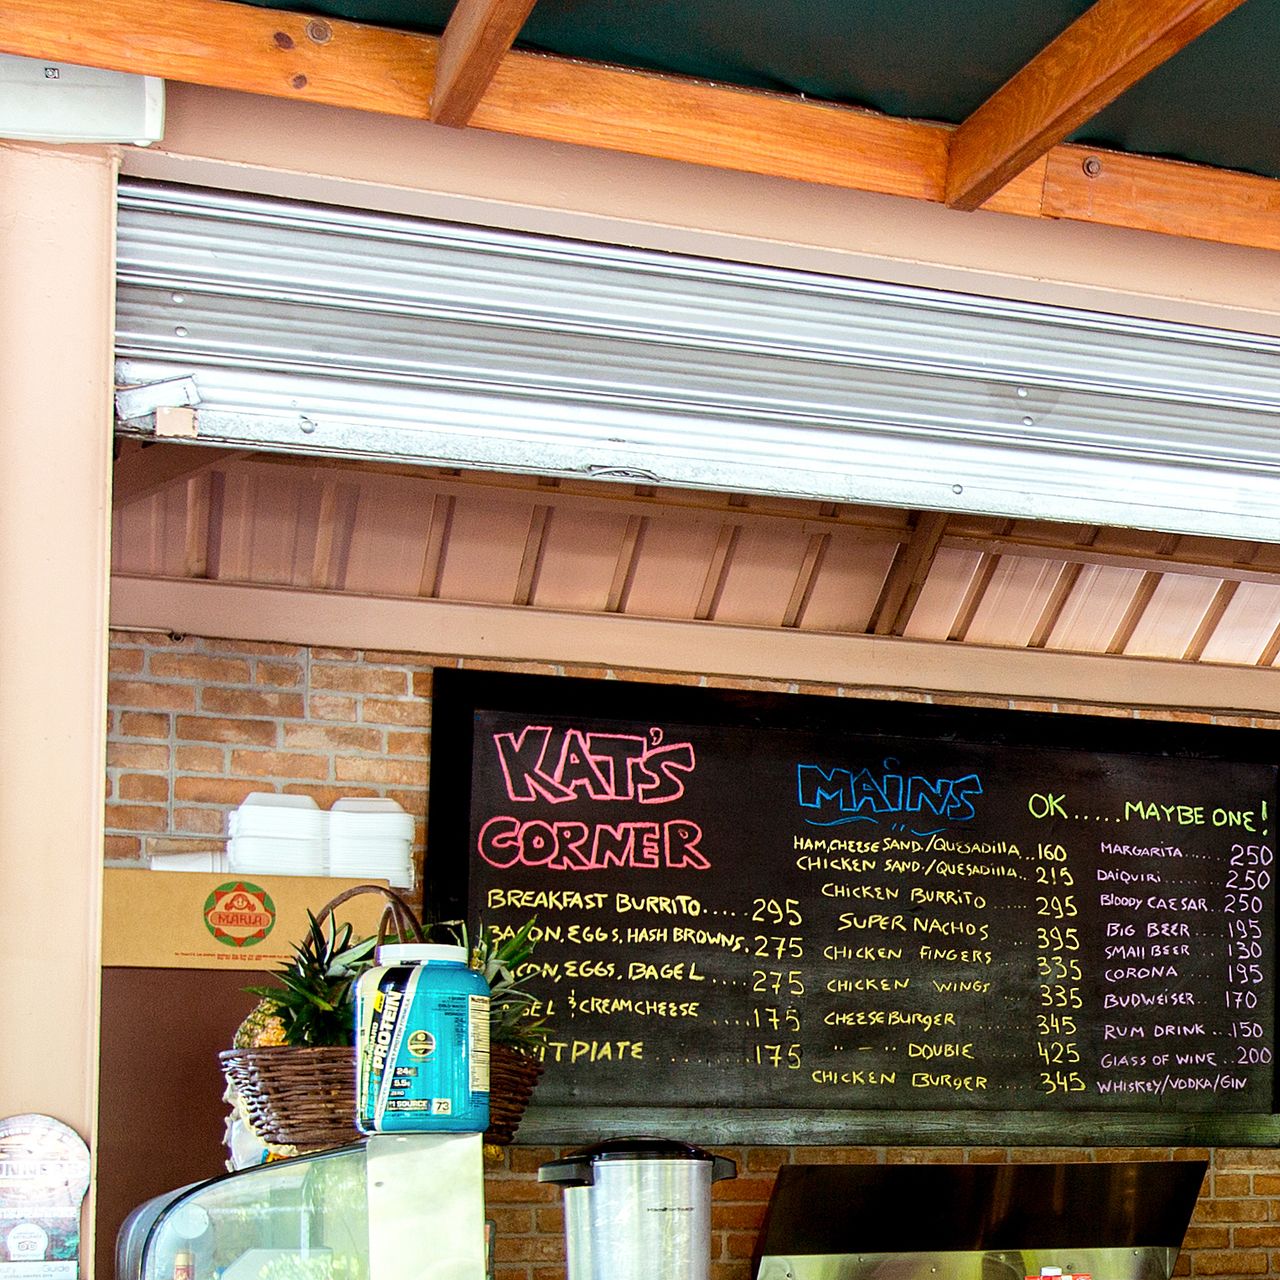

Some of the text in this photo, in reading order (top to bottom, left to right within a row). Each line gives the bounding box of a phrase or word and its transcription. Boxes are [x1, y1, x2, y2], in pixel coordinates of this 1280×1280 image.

[494, 726, 695, 804] KAT'S
[1125, 801, 1204, 825] MAYBE
[478, 816, 711, 870] CORNER
[1038, 843, 1067, 862] 160
[1230, 844, 1273, 866] 250
[796, 856, 876, 872] CHICKEN
[1035, 866, 1074, 886] 215
[1225, 870, 1270, 890] 250
[487, 888, 803, 926] BREAKFAST BURRITO 295
[1036, 896, 1078, 919] 295
[1147, 897, 1208, 912] CAESAR
[1224, 894, 1263, 914] 250
[218, 914, 262, 924] MARIA
[1106, 919, 1262, 939] BIG BEER 195
[627, 928, 668, 943] HASH
[754, 935, 803, 959] 275
[837, 913, 1080, 951] SUPER NACHOS 395
[1151, 945, 1190, 957] BEER
[1228, 941, 1263, 959] 130
[823, 946, 1082, 981] CHICKEN FINGERS 335
[1104, 963, 1264, 984] CORONA 195
[628, 962, 705, 982] BAGEL
[752, 970, 805, 996] 275
[826, 978, 1083, 1009] CHICKEN WINGS 335
[1225, 990, 1258, 1009] 170
[373, 991, 403, 1070] PROTEIN
[754, 1008, 801, 1032] 175
[1037, 1013, 1077, 1035] 345
[1104, 1021, 1264, 1040] RUM DRINK 150
[756, 1043, 801, 1070] 175
[1038, 1042, 1080, 1065] 425
[1152, 1054, 1169, 1066] OF
[1176, 1052, 1217, 1067] WINE
[1237, 1046, 1272, 1065] 200
[811, 1070, 896, 1084] CHICKEN
[1040, 1071, 1086, 1094] 345
[436, 1101, 450, 1112] 73
